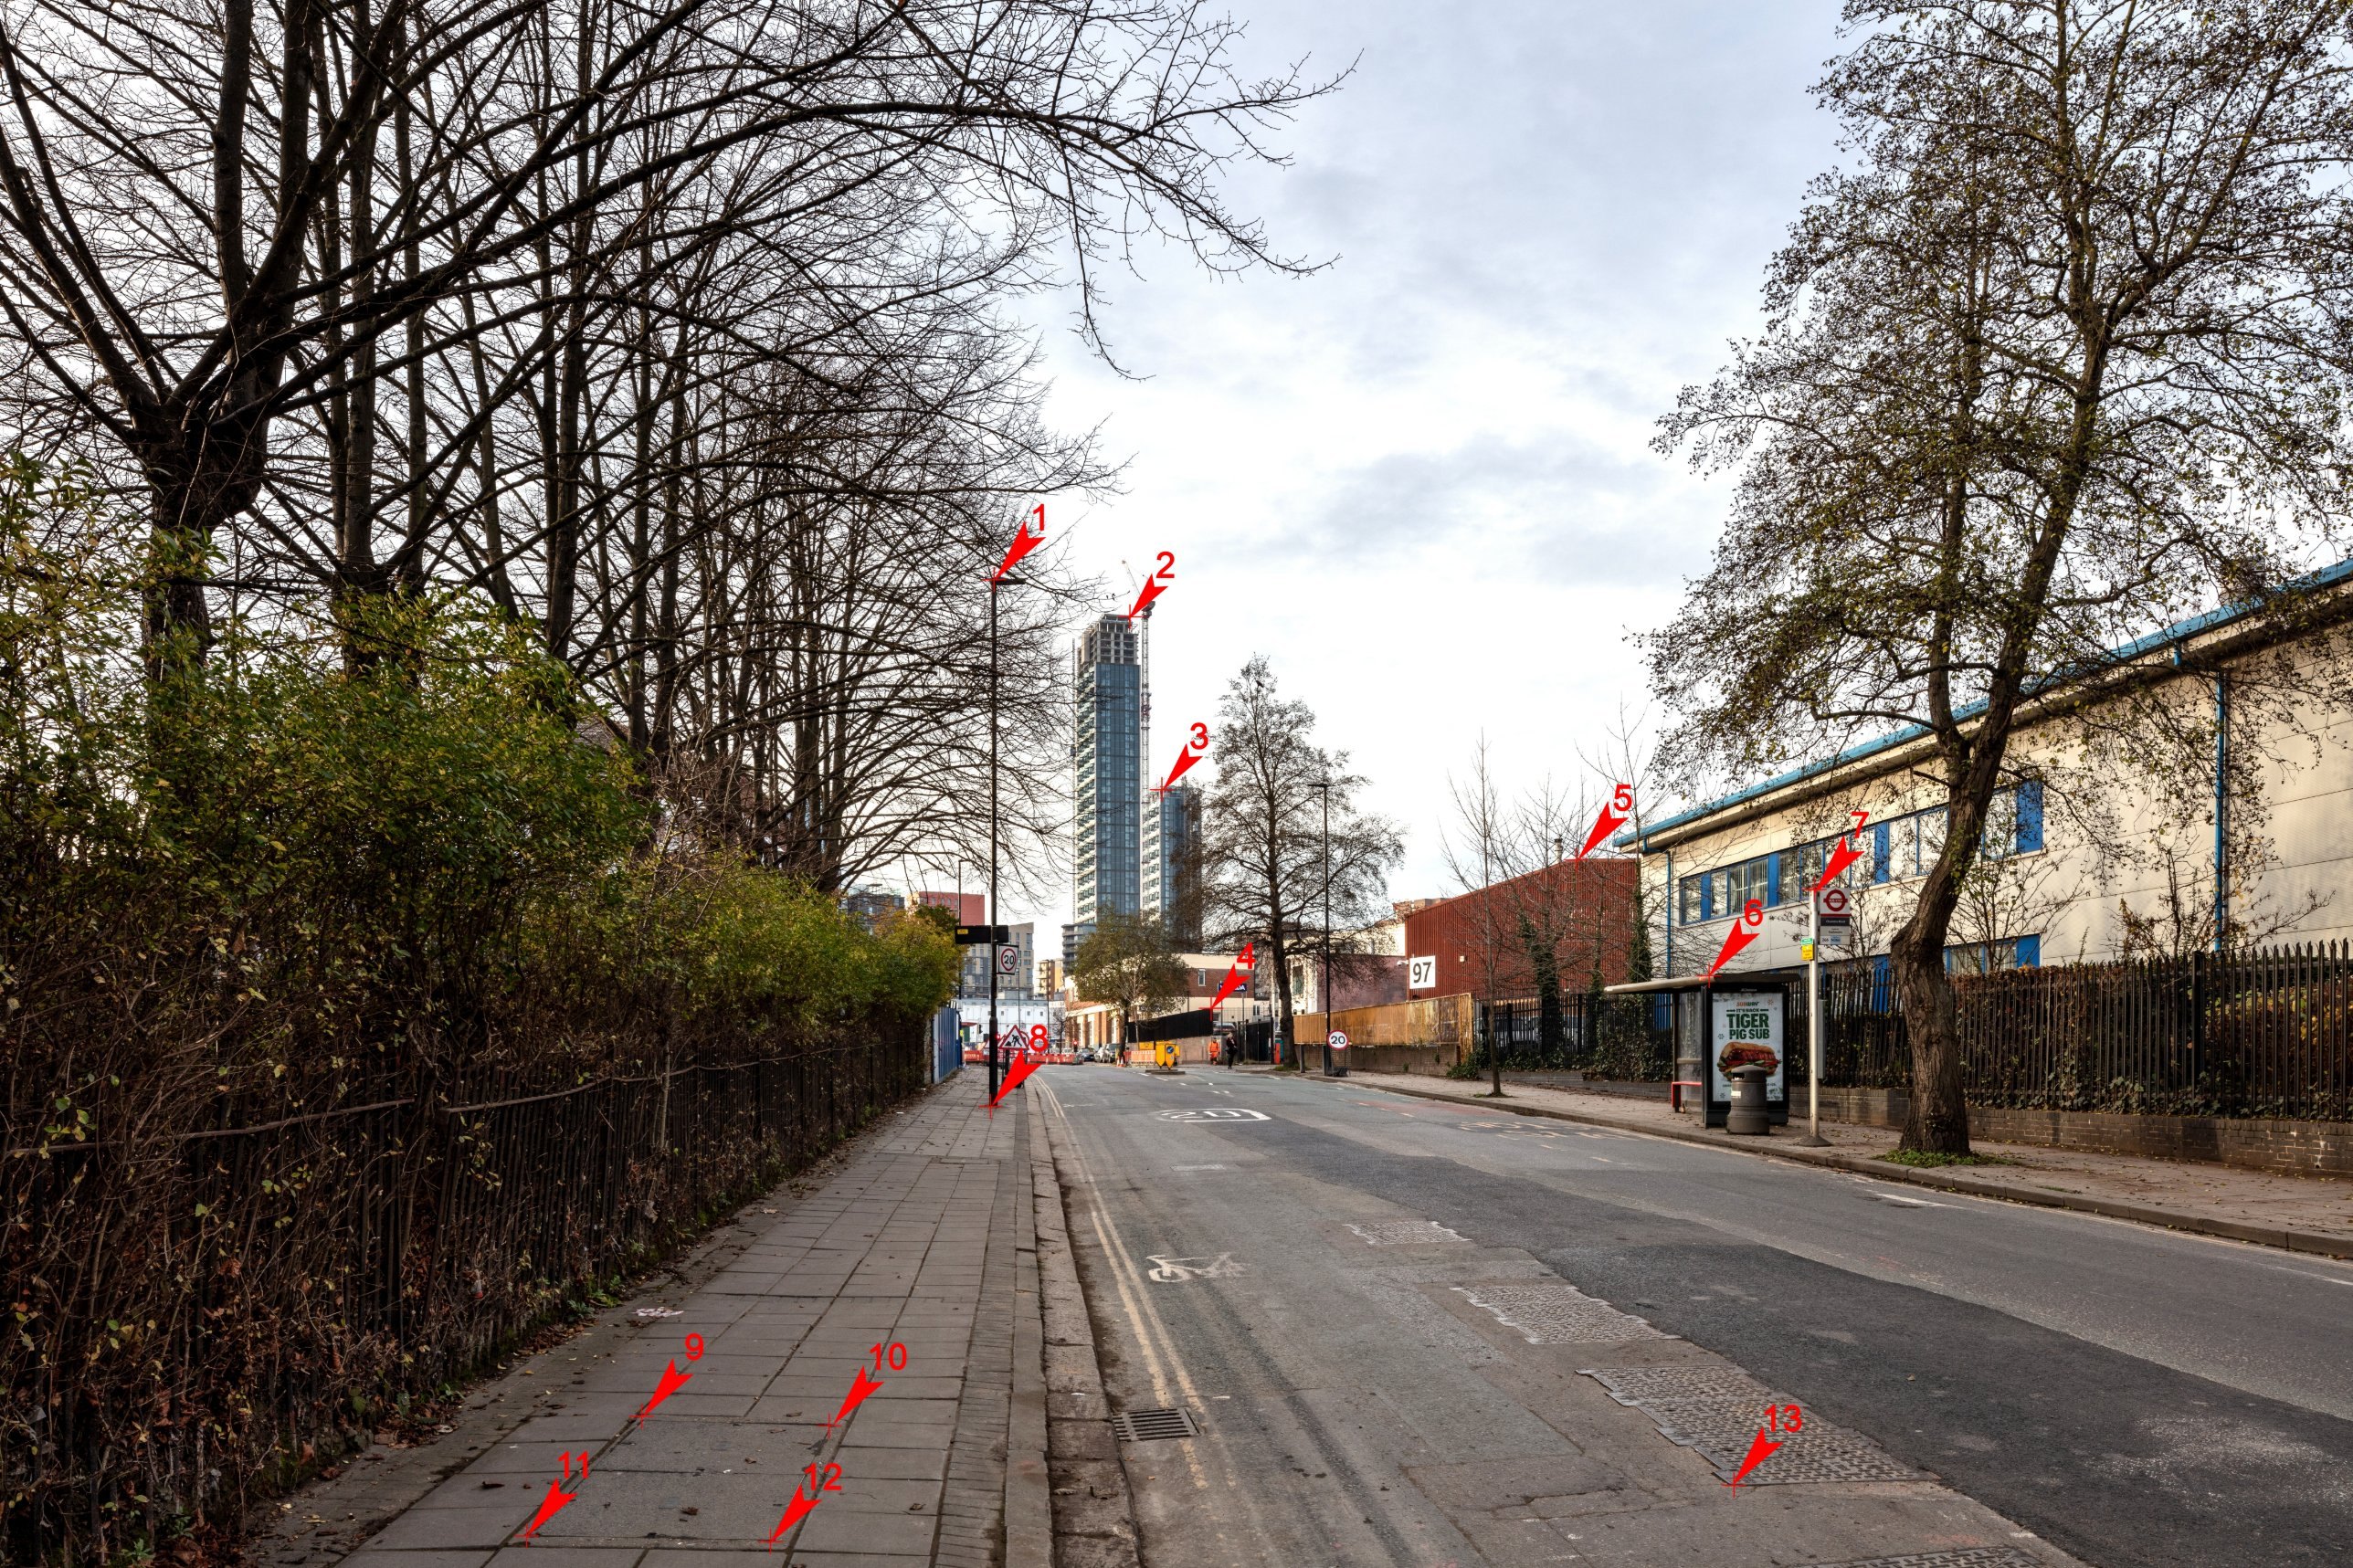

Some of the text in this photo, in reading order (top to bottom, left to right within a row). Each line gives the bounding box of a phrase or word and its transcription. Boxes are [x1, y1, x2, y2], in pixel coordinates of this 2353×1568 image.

[1004, 954, 1015, 965] 20
[1412, 962, 1432, 984] 97
[1725, 1013, 1769, 1028] TIGER
[1729, 1028, 1770, 1039] PIG SUB
[1330, 1036, 1345, 1045] 20
[1161, 1110, 1242, 1120] 20
